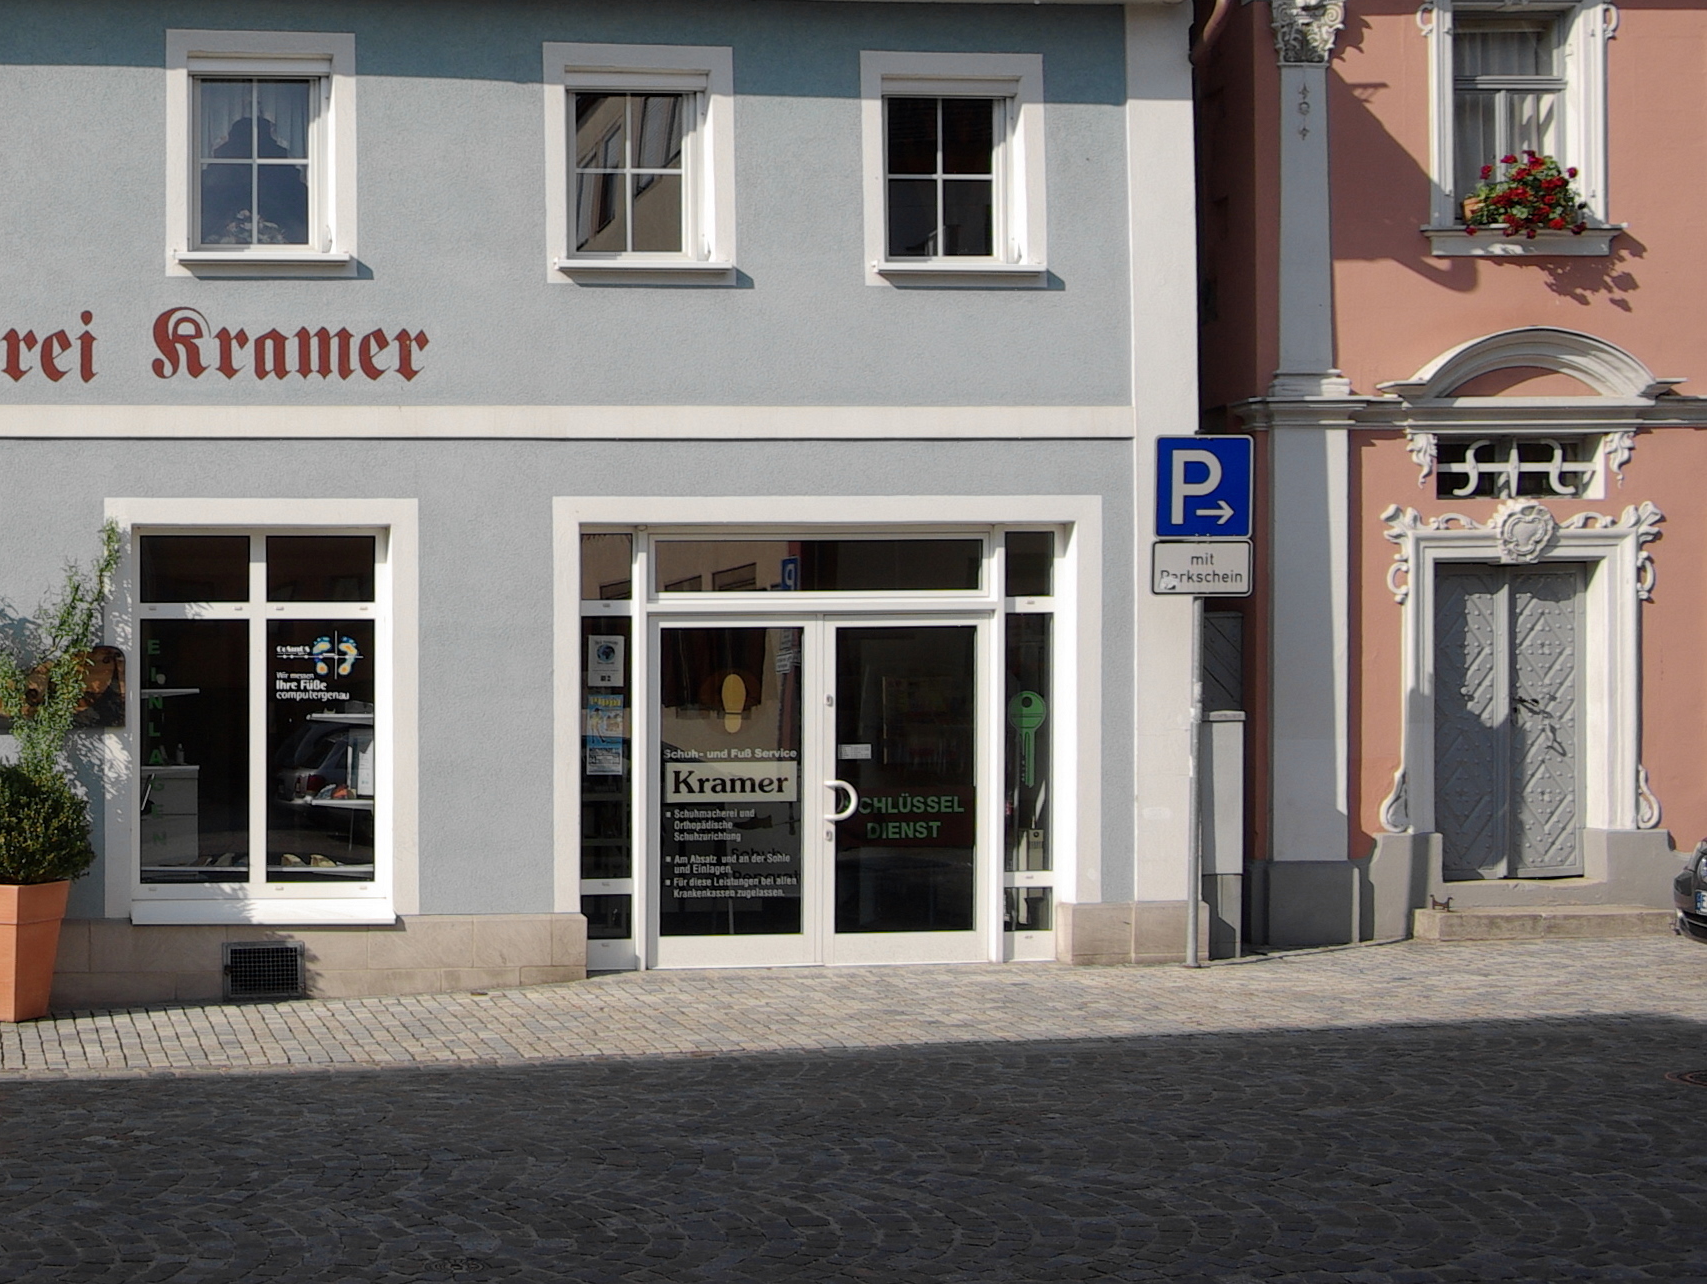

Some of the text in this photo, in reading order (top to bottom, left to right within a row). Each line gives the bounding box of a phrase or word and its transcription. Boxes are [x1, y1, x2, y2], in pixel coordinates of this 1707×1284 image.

[152, 306, 430, 382] Kramer
[1171, 449, 1222, 525] P
[1191, 553, 1214, 566] mit
[276, 679, 327, 690] Ihre Füße
[276, 690, 350, 701] computergenau
[663, 748, 797, 759] Schuh- und Fuß Service
[673, 770, 788, 794] Kramer
[858, 793, 965, 814] CHLÜSSEL
[674, 809, 755, 818] Schuhmacherei und
[674, 821, 733, 831] Orthopädische
[867, 821, 941, 839] DIENST
[674, 832, 742, 842] Schuhzurichtung
[674, 855, 688, 864] Am
[690, 854, 717, 864] Absatz
[721, 854, 736, 863] und
[751, 854, 765, 863] der
[766, 853, 791, 863] Sohle
[674, 865, 690, 874] und
[673, 876, 797, 887] Für diese Leistungen bei allen
[673, 889, 735, 898] Krankenkassen
